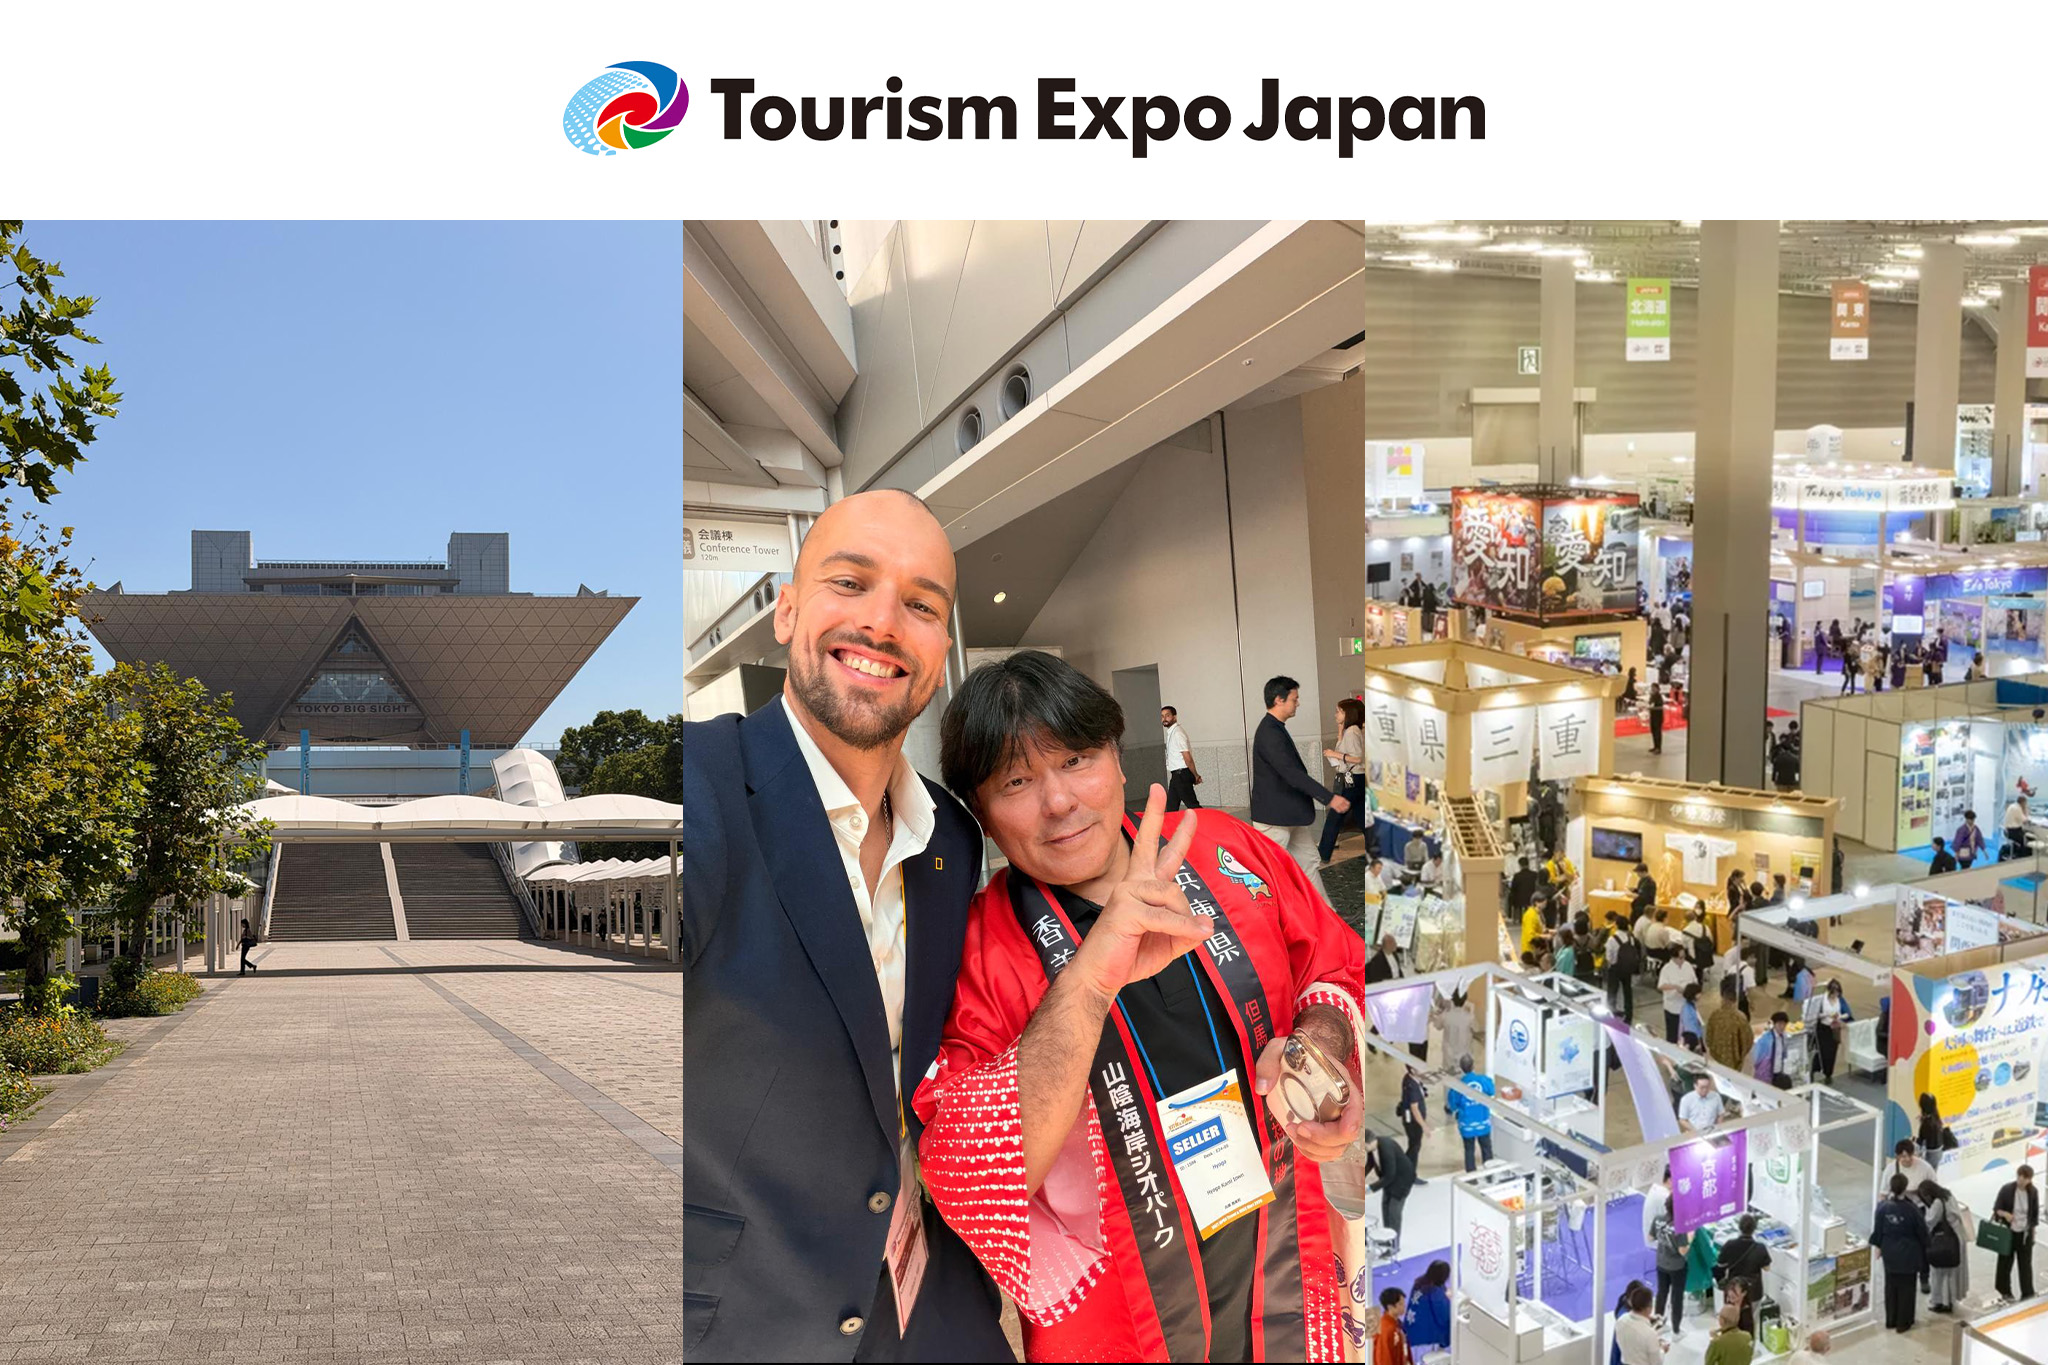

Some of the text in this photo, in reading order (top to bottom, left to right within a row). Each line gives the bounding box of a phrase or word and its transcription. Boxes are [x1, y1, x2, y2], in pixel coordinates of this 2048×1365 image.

[1843, 486, 1882, 501] Tokyo
[698, 529, 734, 541] 会議棟
[699, 543, 751, 553] Conference
[753, 545, 780, 556] Tower
[1459, 507, 1531, 590] 愛知
[1555, 529, 1628, 588] 愛知
[296, 705, 410, 713] TOKYO BIG SIGHT
[1102, 1061, 1174, 1249] 山陰海岸ジオパーク
[1172, 1124, 1221, 1156] SELLER
[1701, 1158, 1718, 1199] 京都
